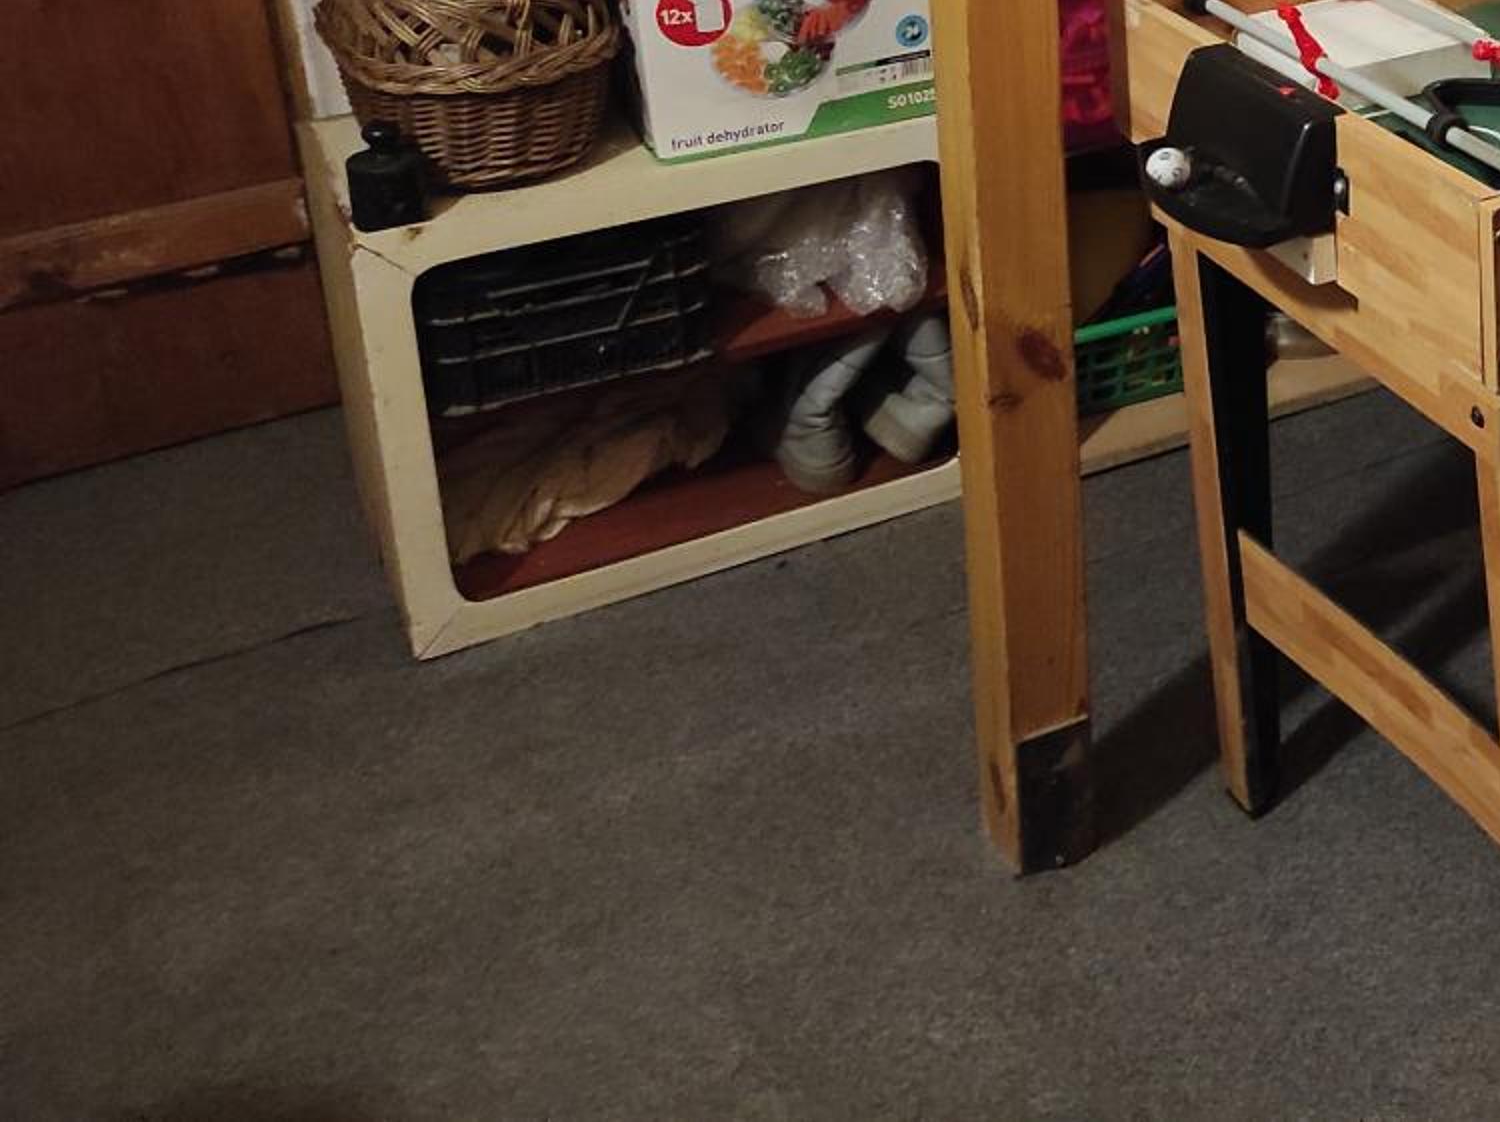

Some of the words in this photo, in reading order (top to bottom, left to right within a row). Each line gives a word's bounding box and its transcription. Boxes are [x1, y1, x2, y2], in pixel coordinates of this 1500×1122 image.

[660, 9, 692, 26] 12x
[671, 135, 703, 151] fruit
[707, 121, 784, 144] dehydrator
